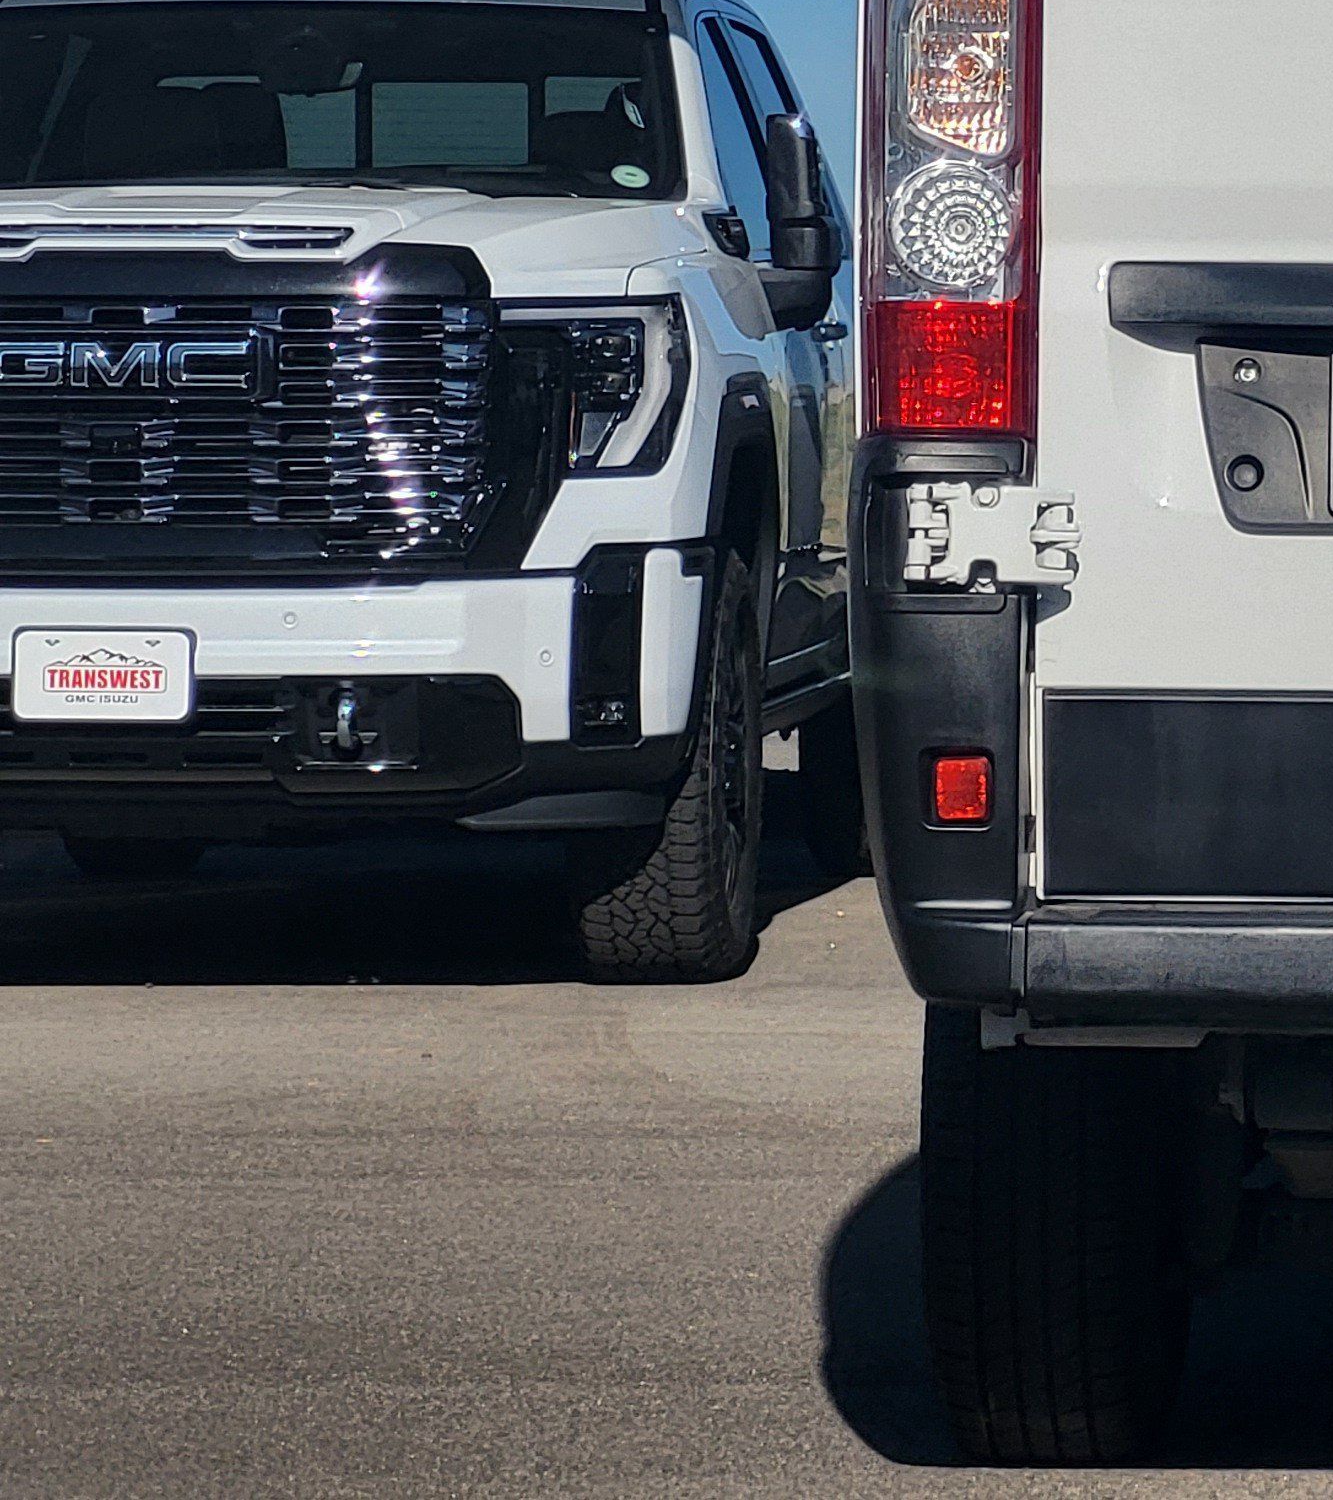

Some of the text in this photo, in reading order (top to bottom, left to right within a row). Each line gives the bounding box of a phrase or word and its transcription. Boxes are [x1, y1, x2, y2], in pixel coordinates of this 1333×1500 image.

[0, 342, 249, 388] GMC
[46, 668, 164, 689] TRANSWEST
[64, 694, 139, 704] GMC ISUZU
